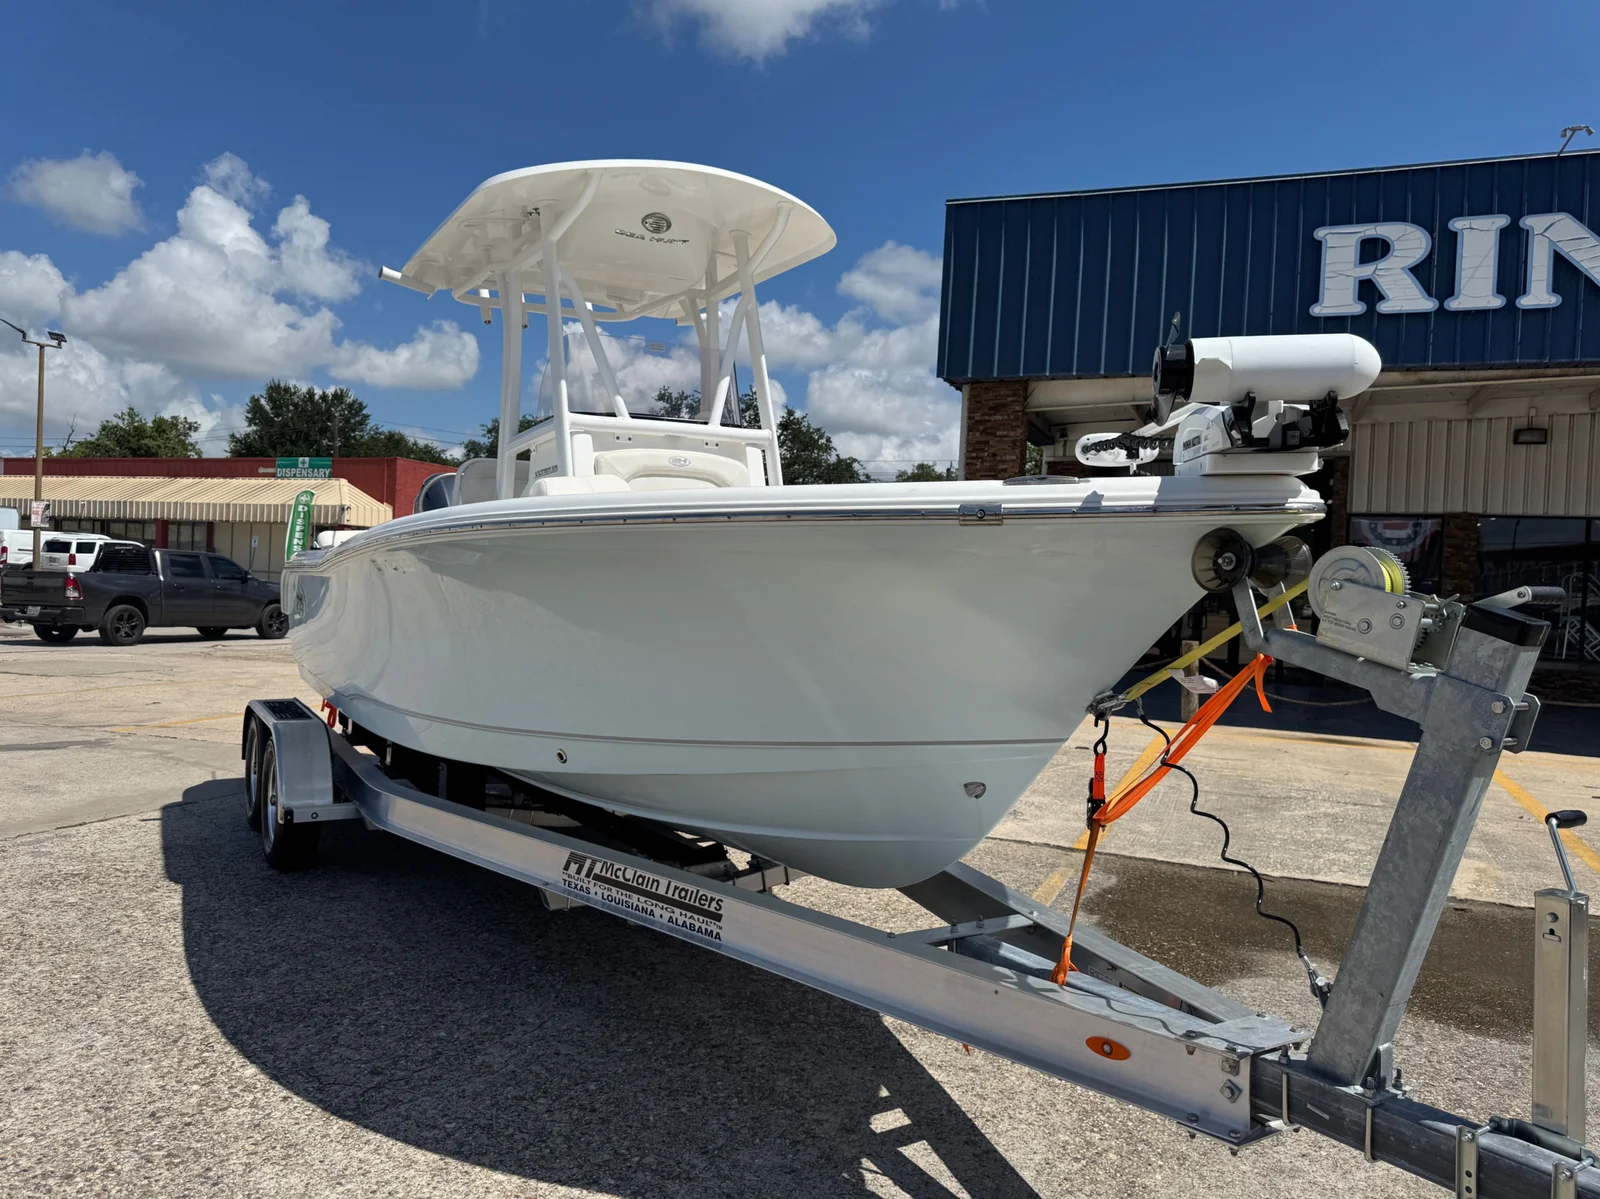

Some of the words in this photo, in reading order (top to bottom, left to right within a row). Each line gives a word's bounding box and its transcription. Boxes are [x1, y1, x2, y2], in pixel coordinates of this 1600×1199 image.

[1309, 212, 1600, 317] RIN
[276, 467, 331, 478] DISPENSARY
[562, 878, 591, 896] TEXAS
[601, 891, 656, 919] LOUISIANA
[667, 915, 722, 942] ALABAMA
[593, 882, 613, 894] FOR
[615, 889, 634, 900] THE
[637, 896, 676, 915] LONG
[599, 860, 661, 892] McClain
[664, 880, 724, 912] Trailers
